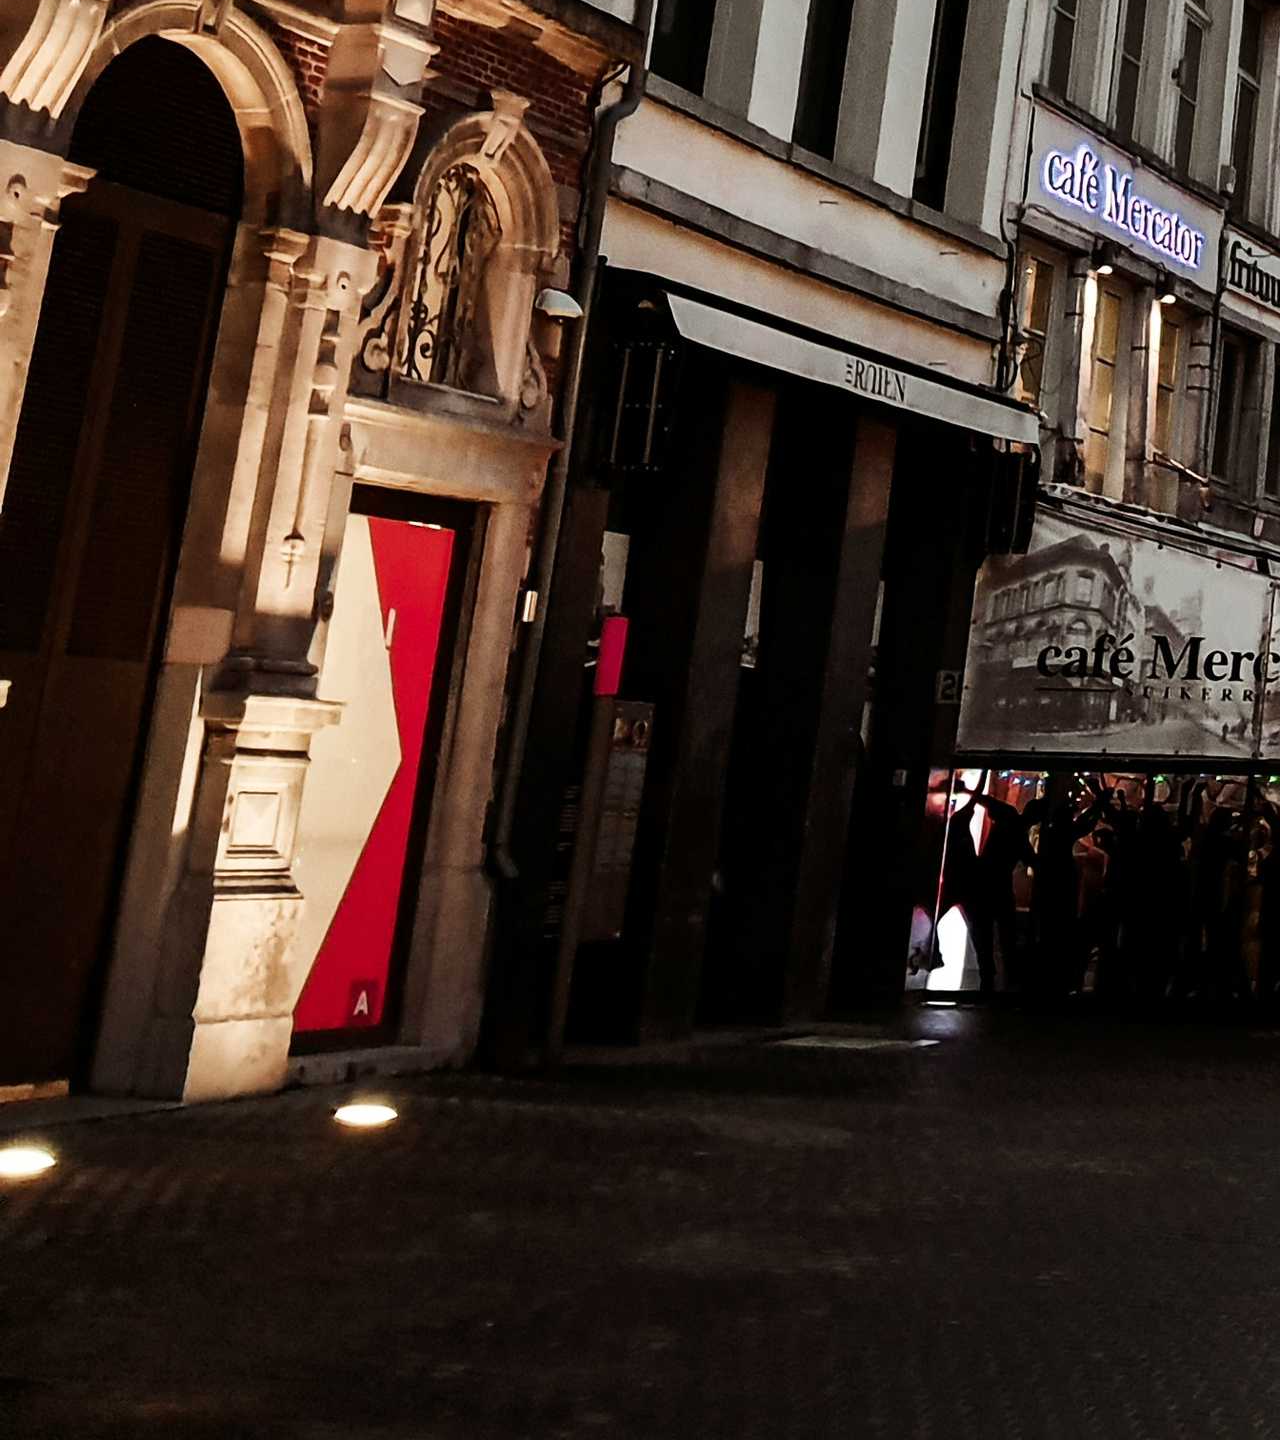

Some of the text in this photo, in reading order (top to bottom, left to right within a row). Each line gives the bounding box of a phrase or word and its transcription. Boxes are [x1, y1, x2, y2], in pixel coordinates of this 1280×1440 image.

[1045, 148, 1203, 266] café Mercator
[1037, 633, 1135, 679] café
[353, 989, 369, 1016] A
